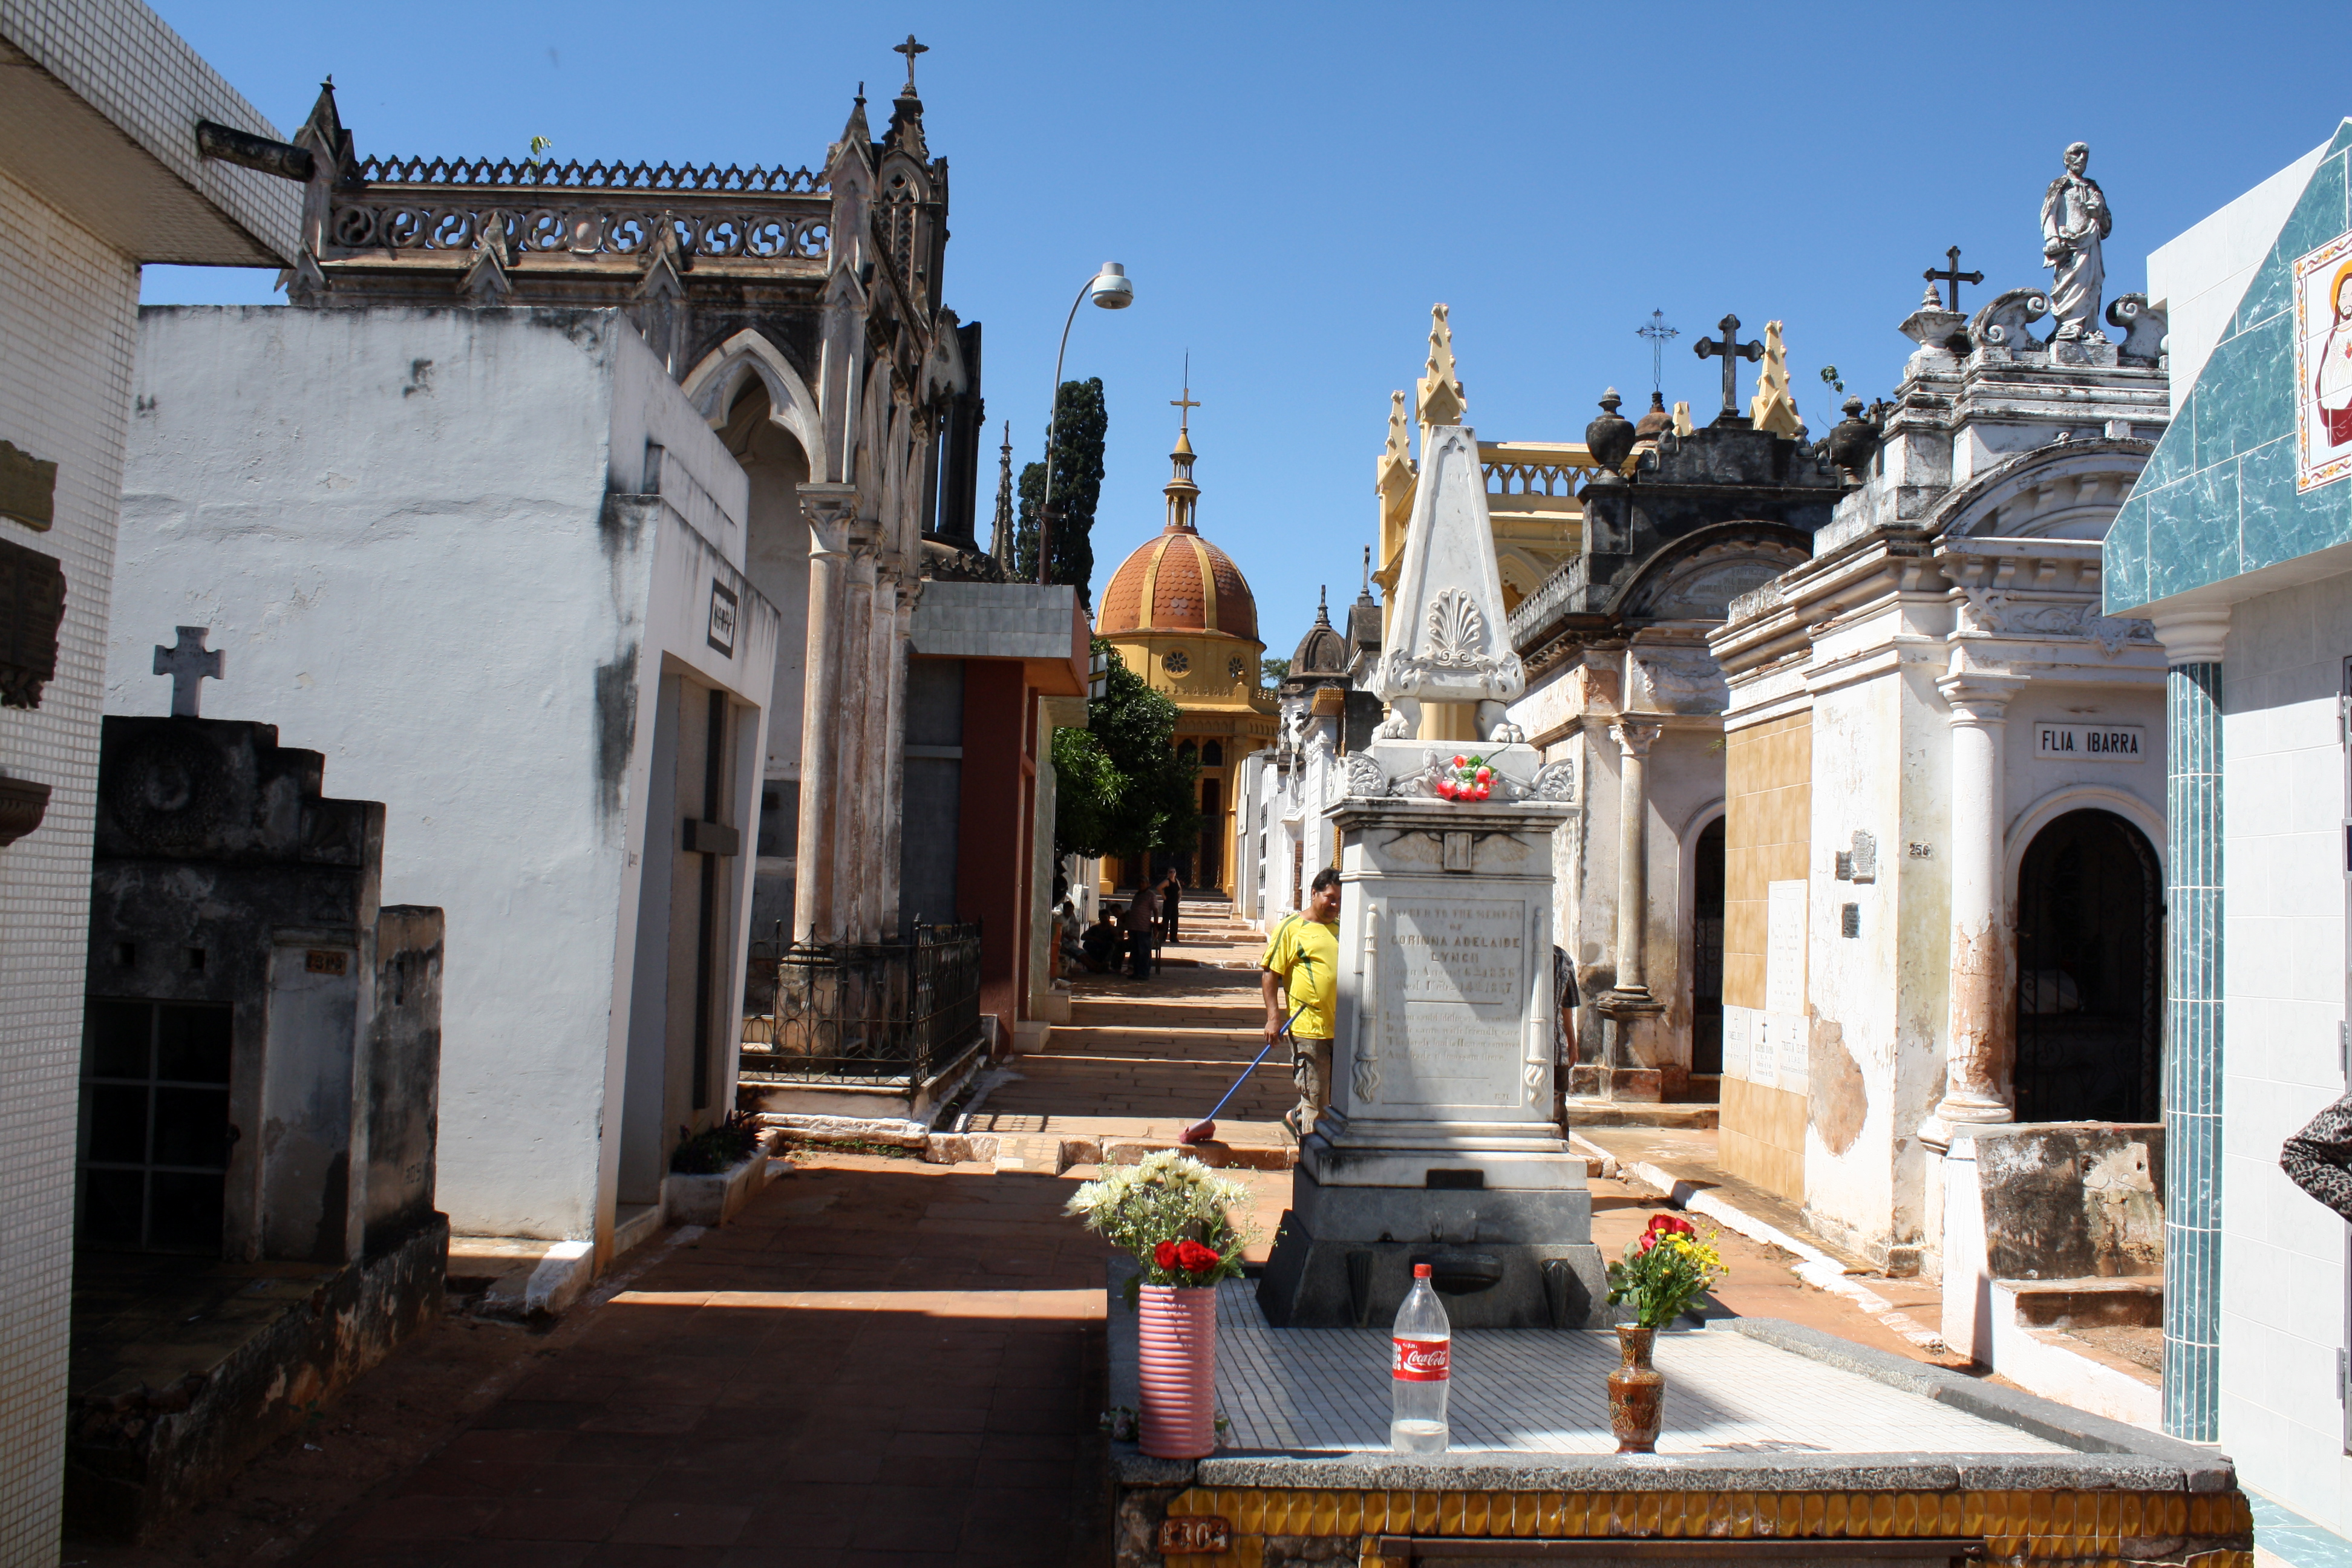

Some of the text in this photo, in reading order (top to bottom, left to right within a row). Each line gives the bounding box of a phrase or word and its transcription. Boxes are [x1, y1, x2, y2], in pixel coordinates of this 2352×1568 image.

[2042, 730, 2138, 754] FLIA. IBARRA
[1434, 909, 1448, 918] TO
[1452, 909, 1473, 919] THE
[1391, 935, 1520, 949] CORINNA ADELAIDE
[1432, 952, 1478, 964] LYNCH
[1407, 1350, 1447, 1367] Coca-Cola
